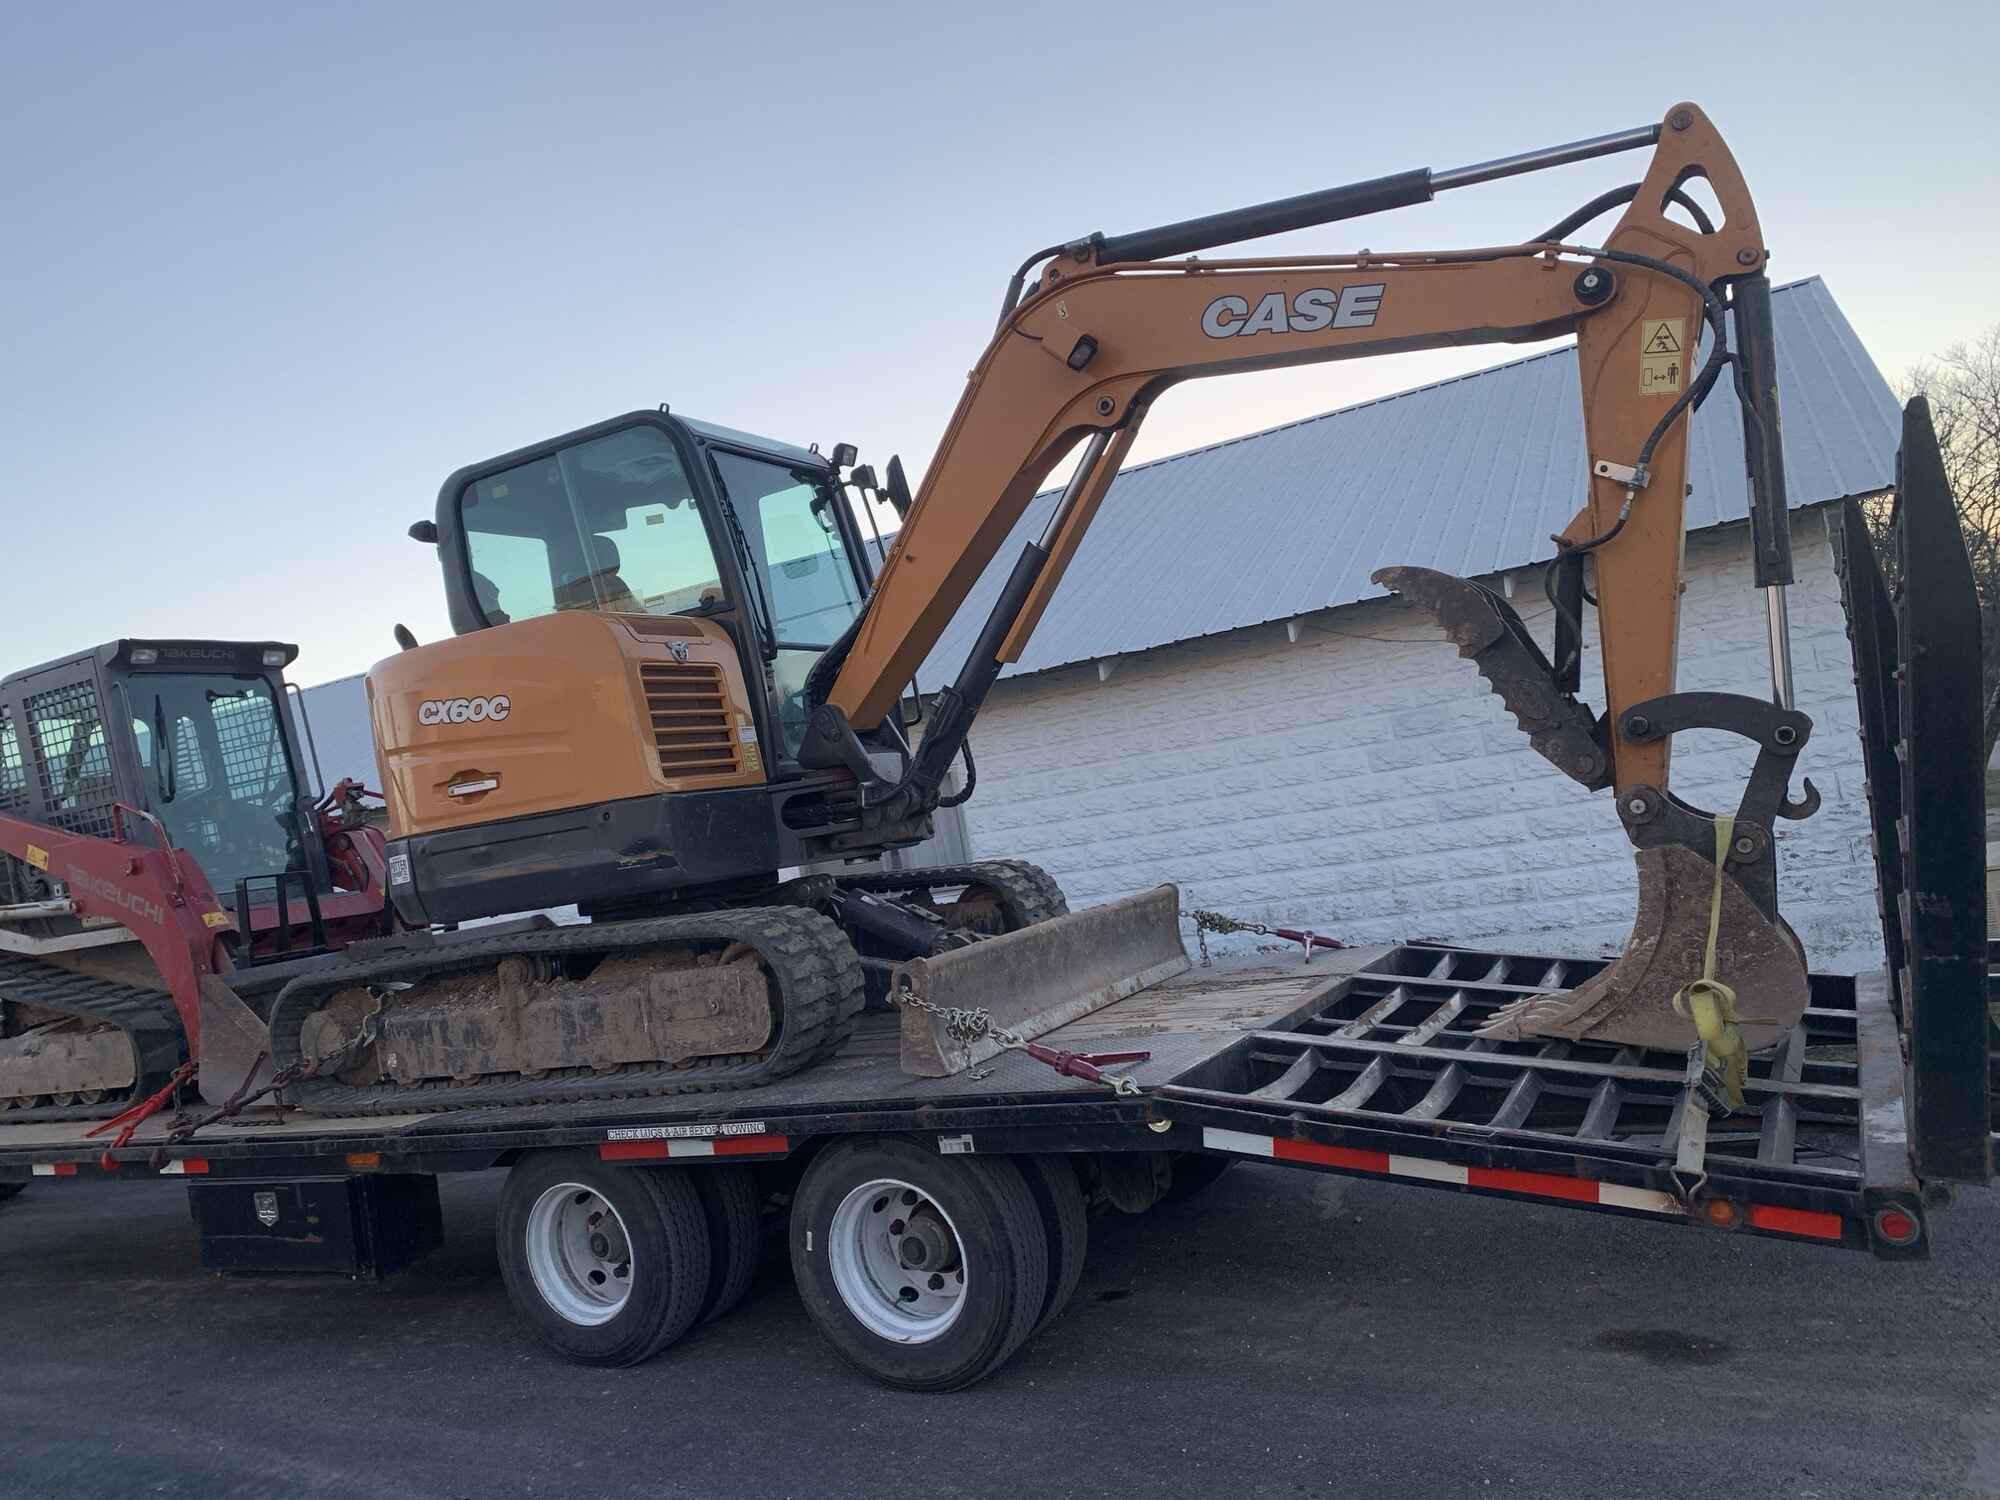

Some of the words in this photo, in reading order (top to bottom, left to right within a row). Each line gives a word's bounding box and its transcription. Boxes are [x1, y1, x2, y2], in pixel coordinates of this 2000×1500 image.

[1201, 284, 1386, 339] CASE
[418, 695, 511, 726] CX60C
[609, 1129, 641, 1139] CHECK
[642, 1128, 663, 1138] LUGS
[664, 1127, 672, 1137] &
[725, 1122, 765, 1134] TOWING
